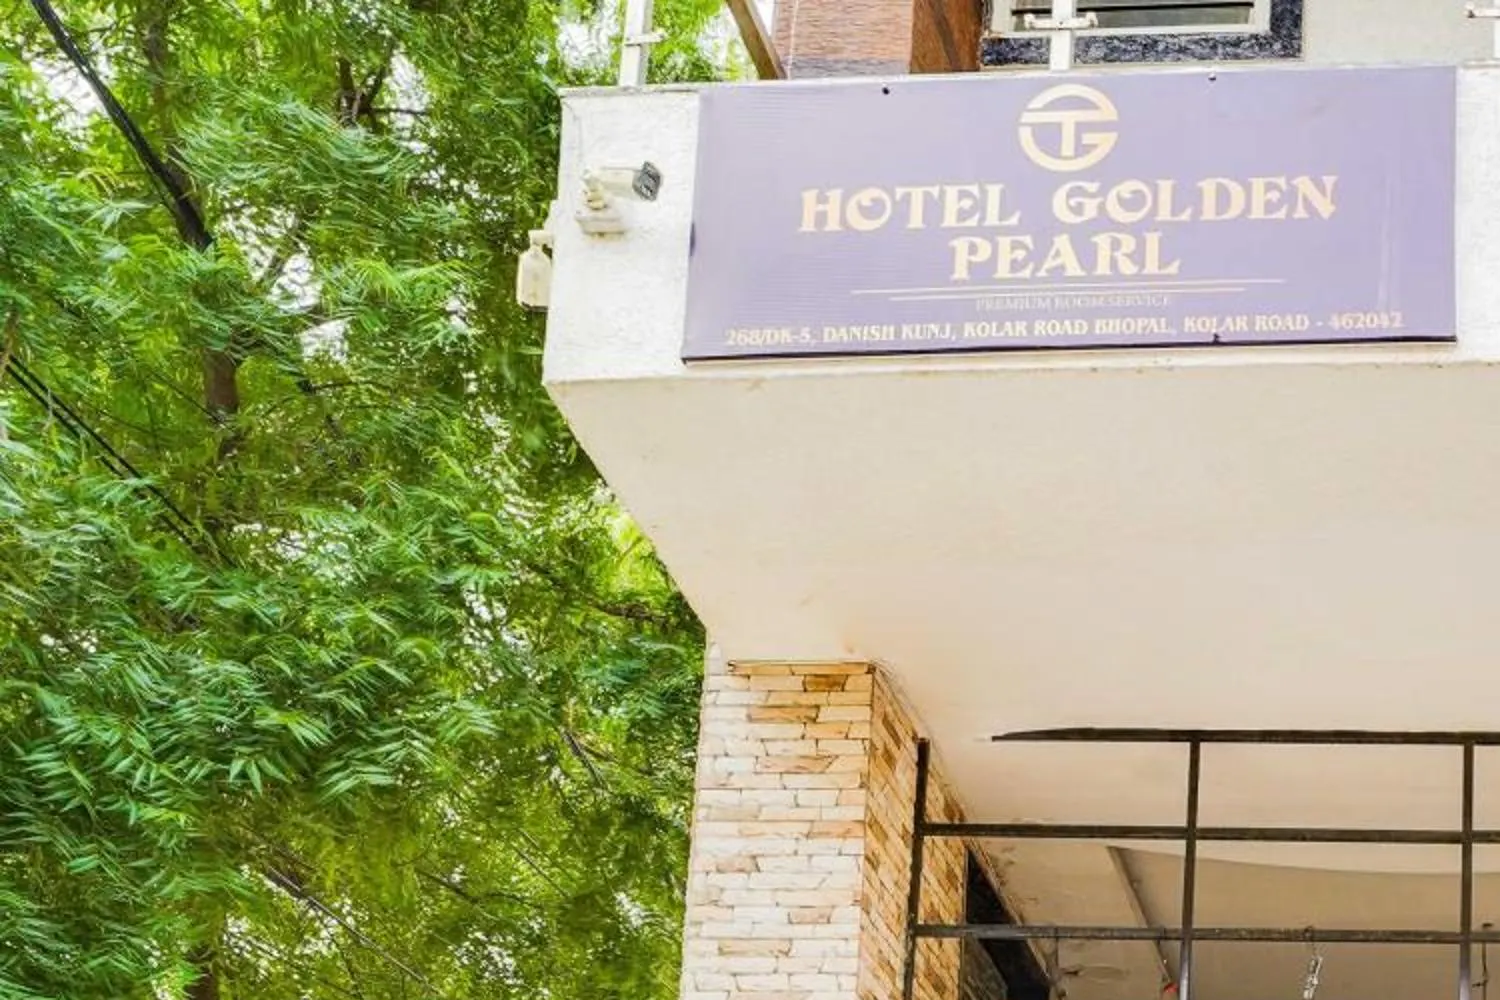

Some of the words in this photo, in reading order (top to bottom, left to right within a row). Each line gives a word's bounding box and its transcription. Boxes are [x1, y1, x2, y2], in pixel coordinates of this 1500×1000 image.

[798, 180, 1020, 234] HOTEL
[1050, 175, 1337, 226] GOLDEN
[949, 230, 1180, 282] PEARL
[725, 328, 817, 347] 268/DK-5,
[822, 324, 896, 344] DANISH
[901, 321, 957, 341] KUNJ,
[963, 320, 1028, 339] KOLAR
[1033, 317, 1089, 337] ROAD
[1094, 316, 1178, 335] BHOPAL,
[1184, 314, 1250, 333] KOLAR
[1254, 312, 1310, 332] ROAD
[1328, 311, 1404, 330] 462042
